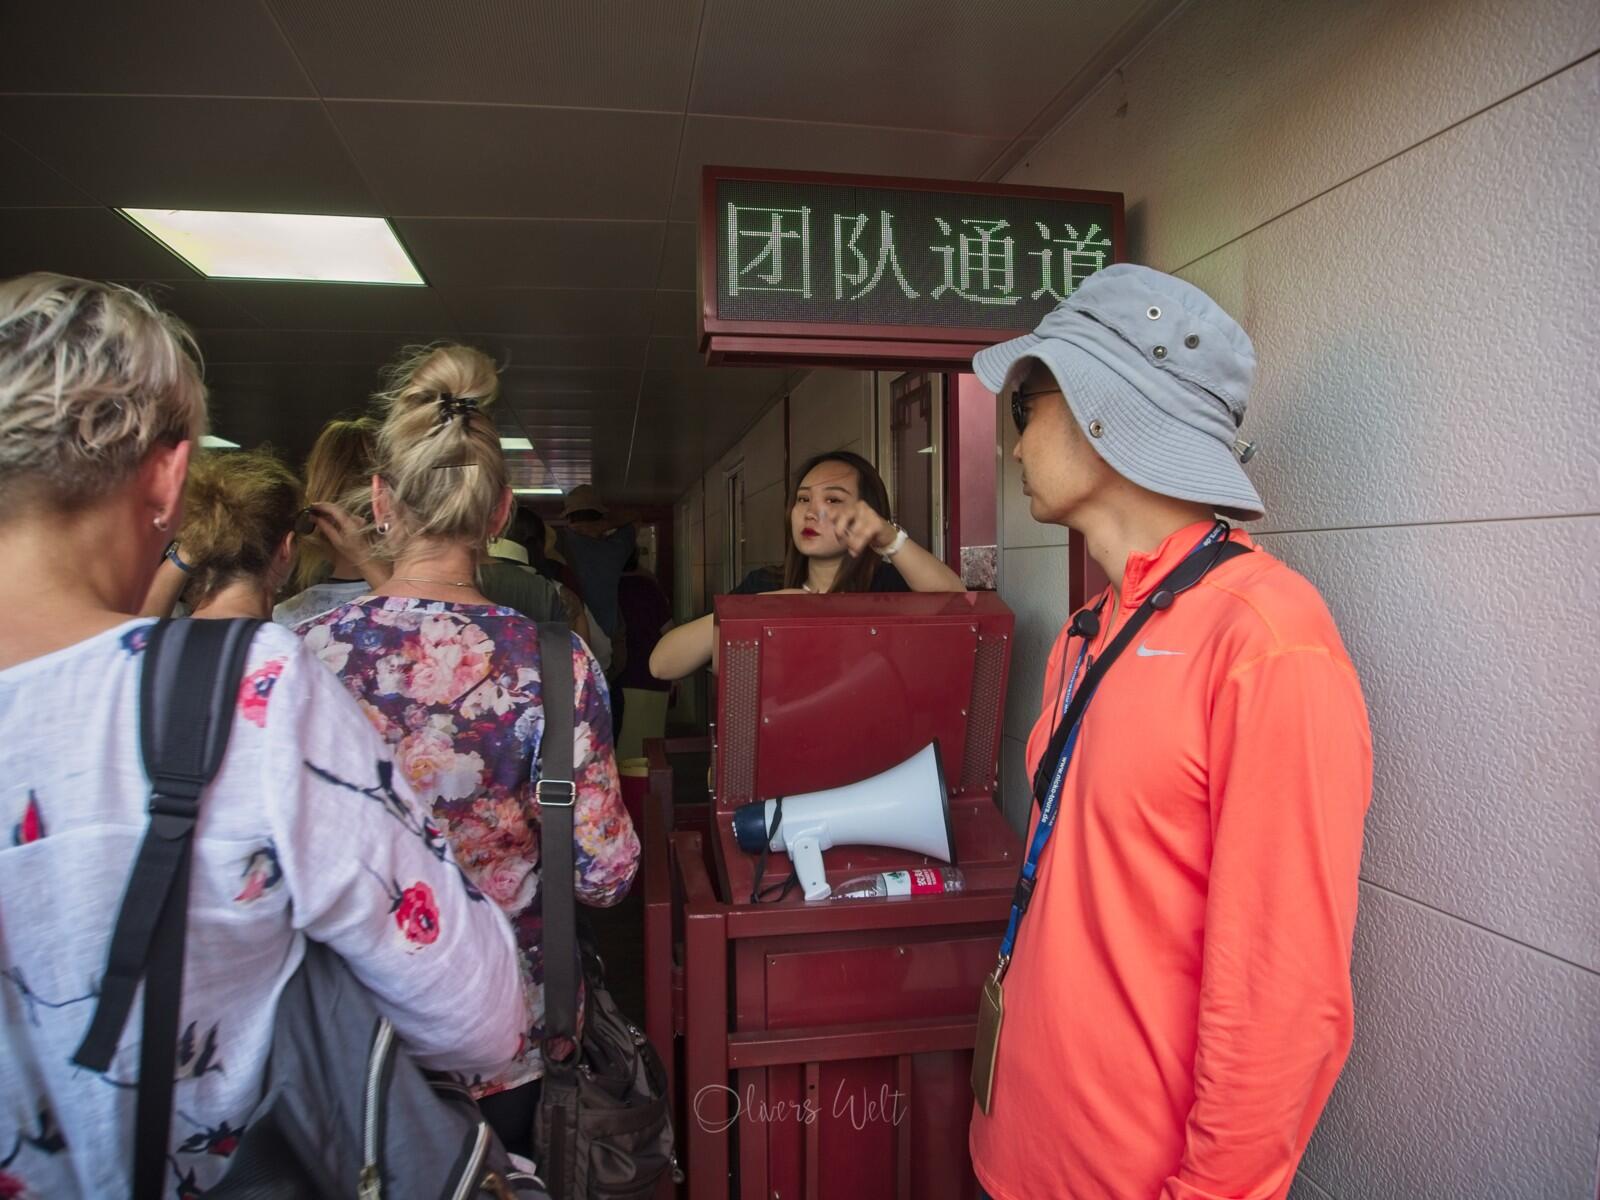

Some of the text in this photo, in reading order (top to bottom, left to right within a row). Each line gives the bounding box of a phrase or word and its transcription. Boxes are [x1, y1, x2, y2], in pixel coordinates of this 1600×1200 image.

[727, 202, 1112, 305] 团队通道
[1041, 756, 1067, 824] www.nicko-tours.de
